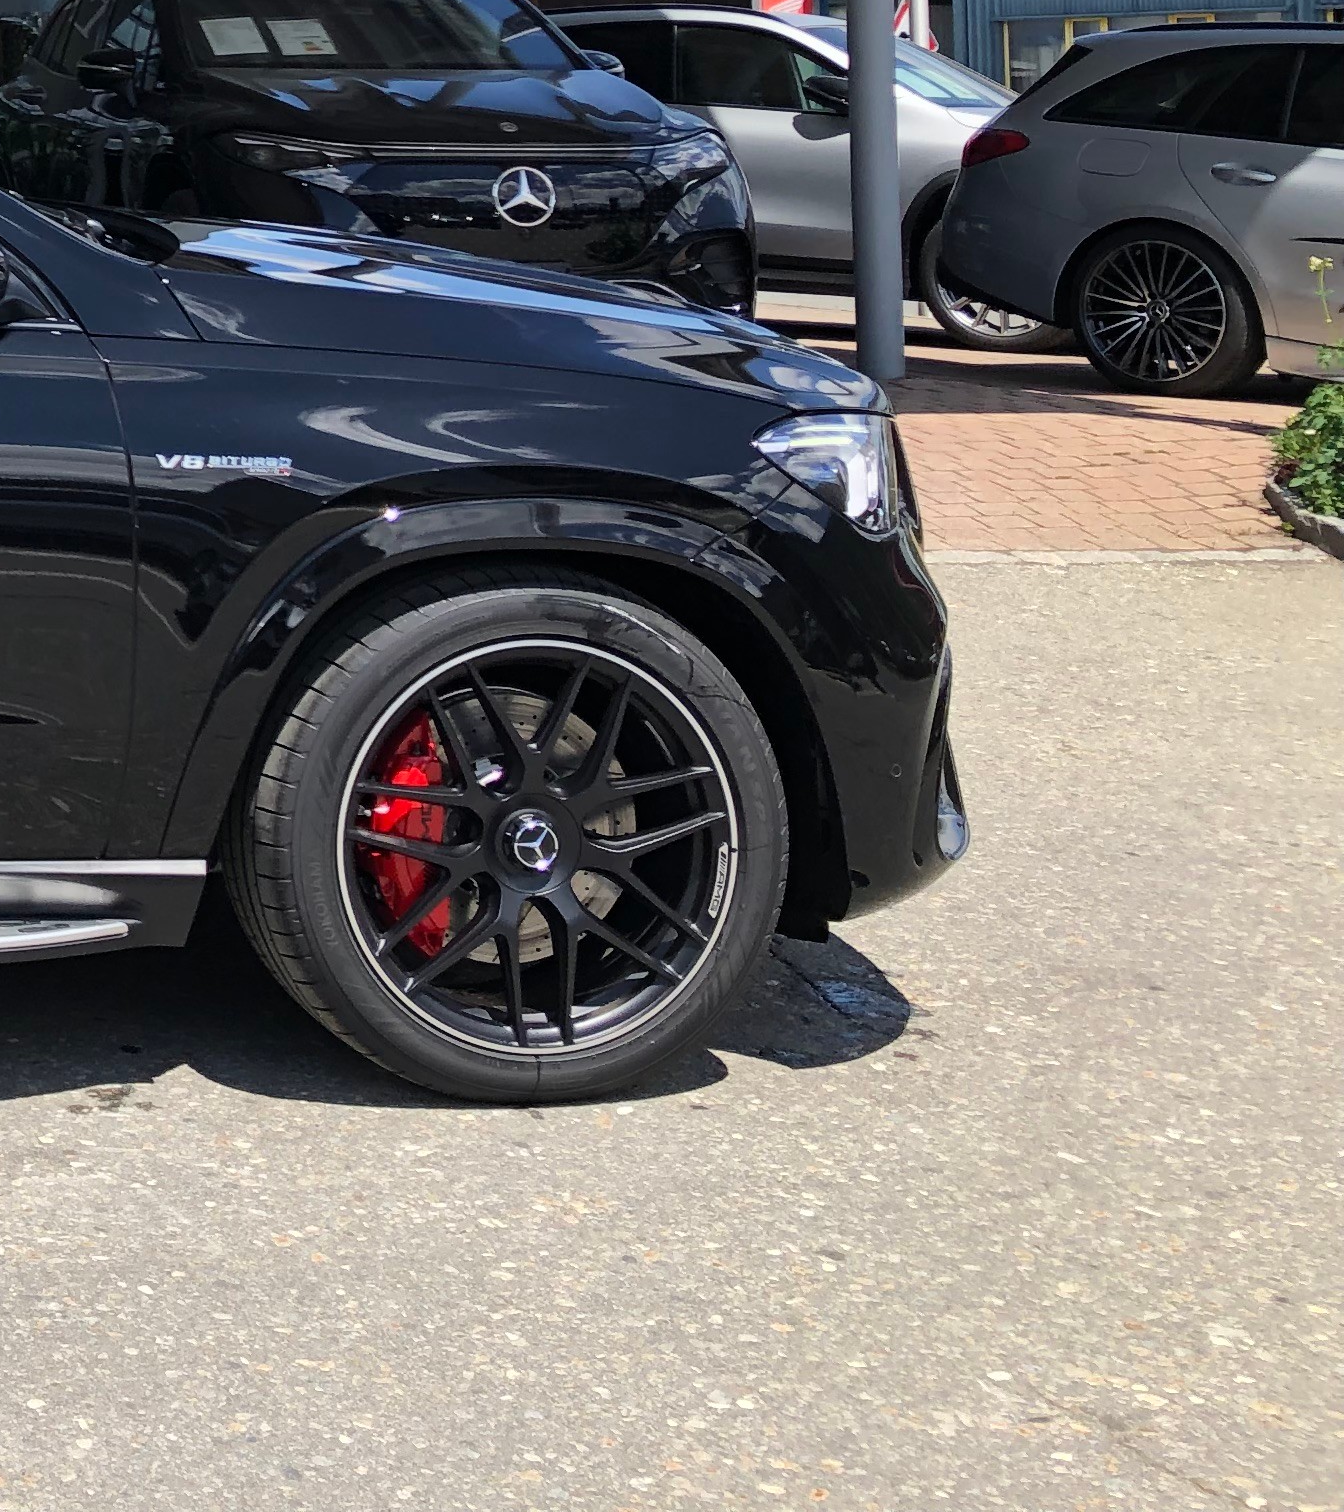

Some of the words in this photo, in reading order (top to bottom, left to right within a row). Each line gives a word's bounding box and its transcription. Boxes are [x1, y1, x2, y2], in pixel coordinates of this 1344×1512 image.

[155, 453, 205, 470] V8
[207, 454, 294, 470] BITURBO
[710, 870, 725, 912] AMG
